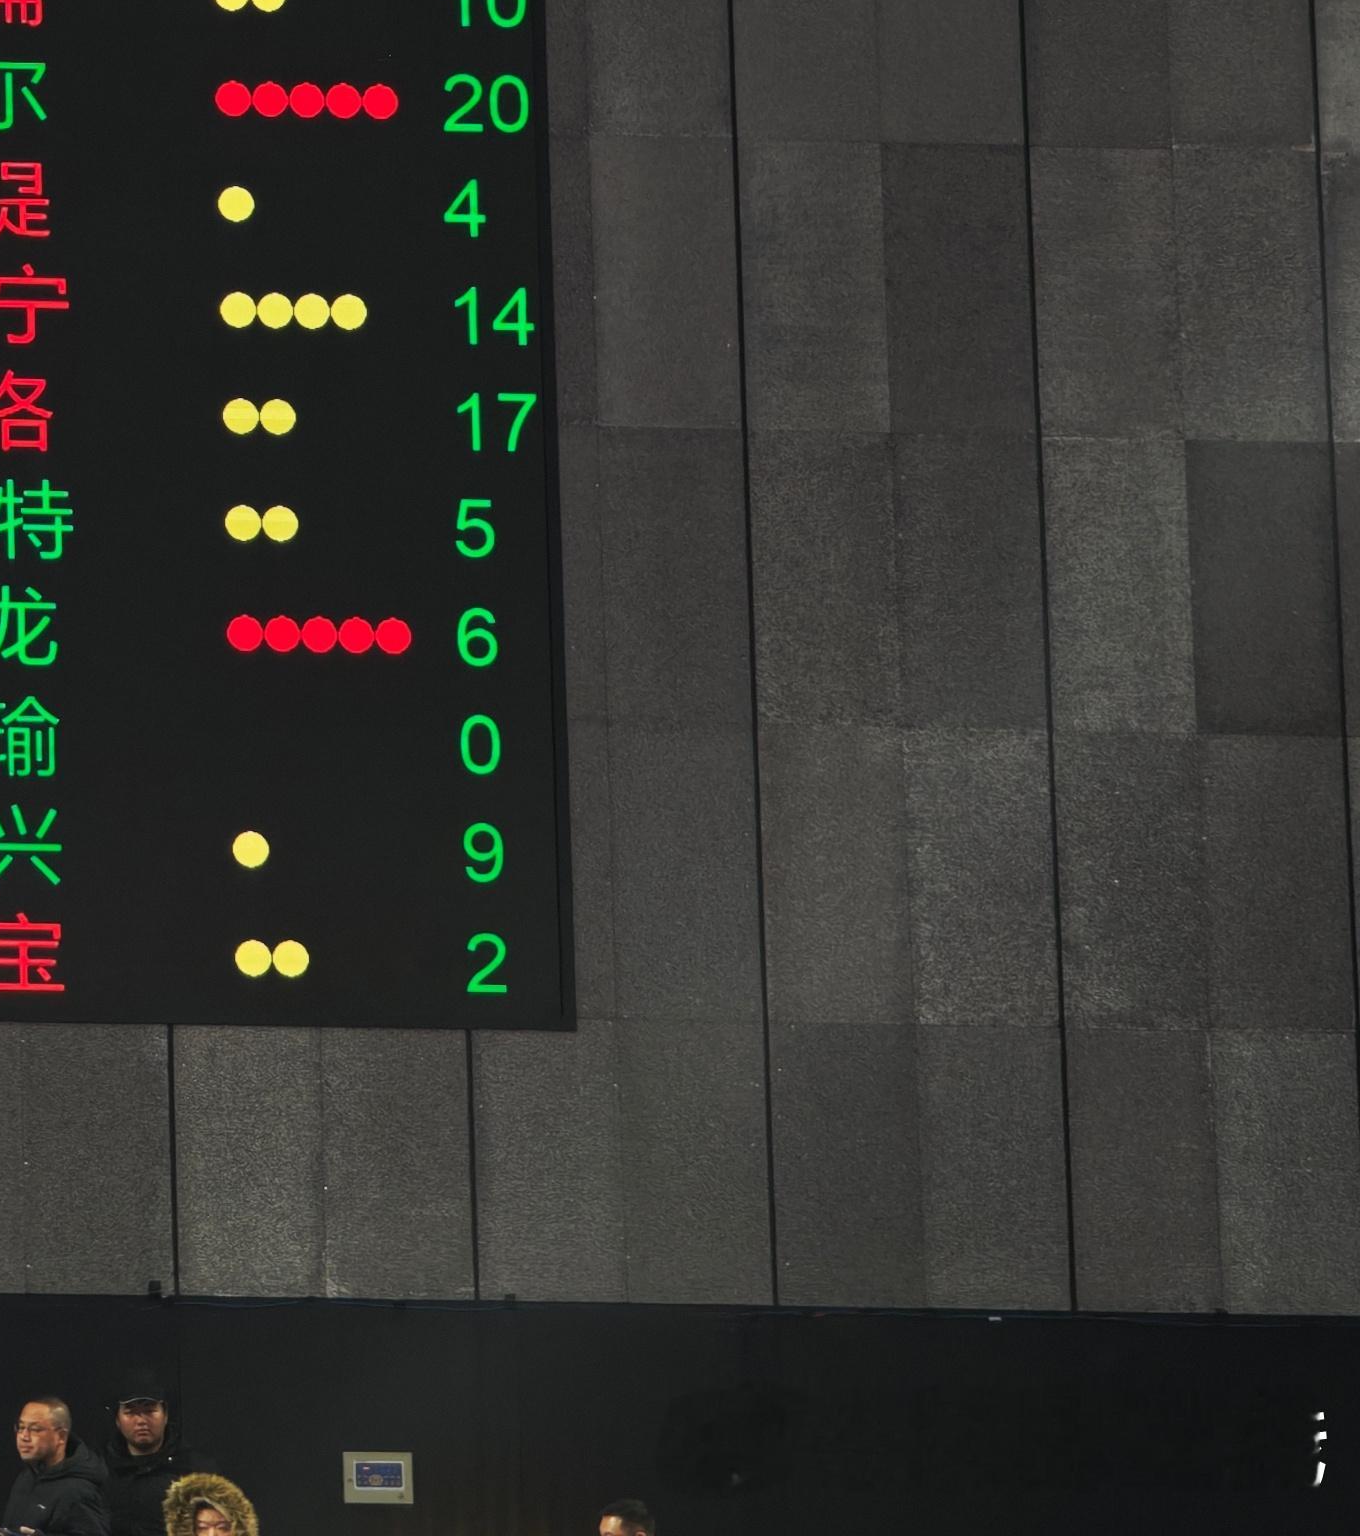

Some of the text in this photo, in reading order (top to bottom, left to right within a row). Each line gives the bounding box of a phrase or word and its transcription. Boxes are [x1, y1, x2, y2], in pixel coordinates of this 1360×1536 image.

[442, 72, 530, 134] 20
[442, 178, 488, 239] 4
[453, 285, 536, 347] 14
[455, 391, 538, 453] 17
[454, 497, 496, 559] 5
[456, 606, 499, 668] 6
[459, 713, 502, 776] 0
[462, 821, 505, 884] 9
[465, 931, 509, 994] 2
